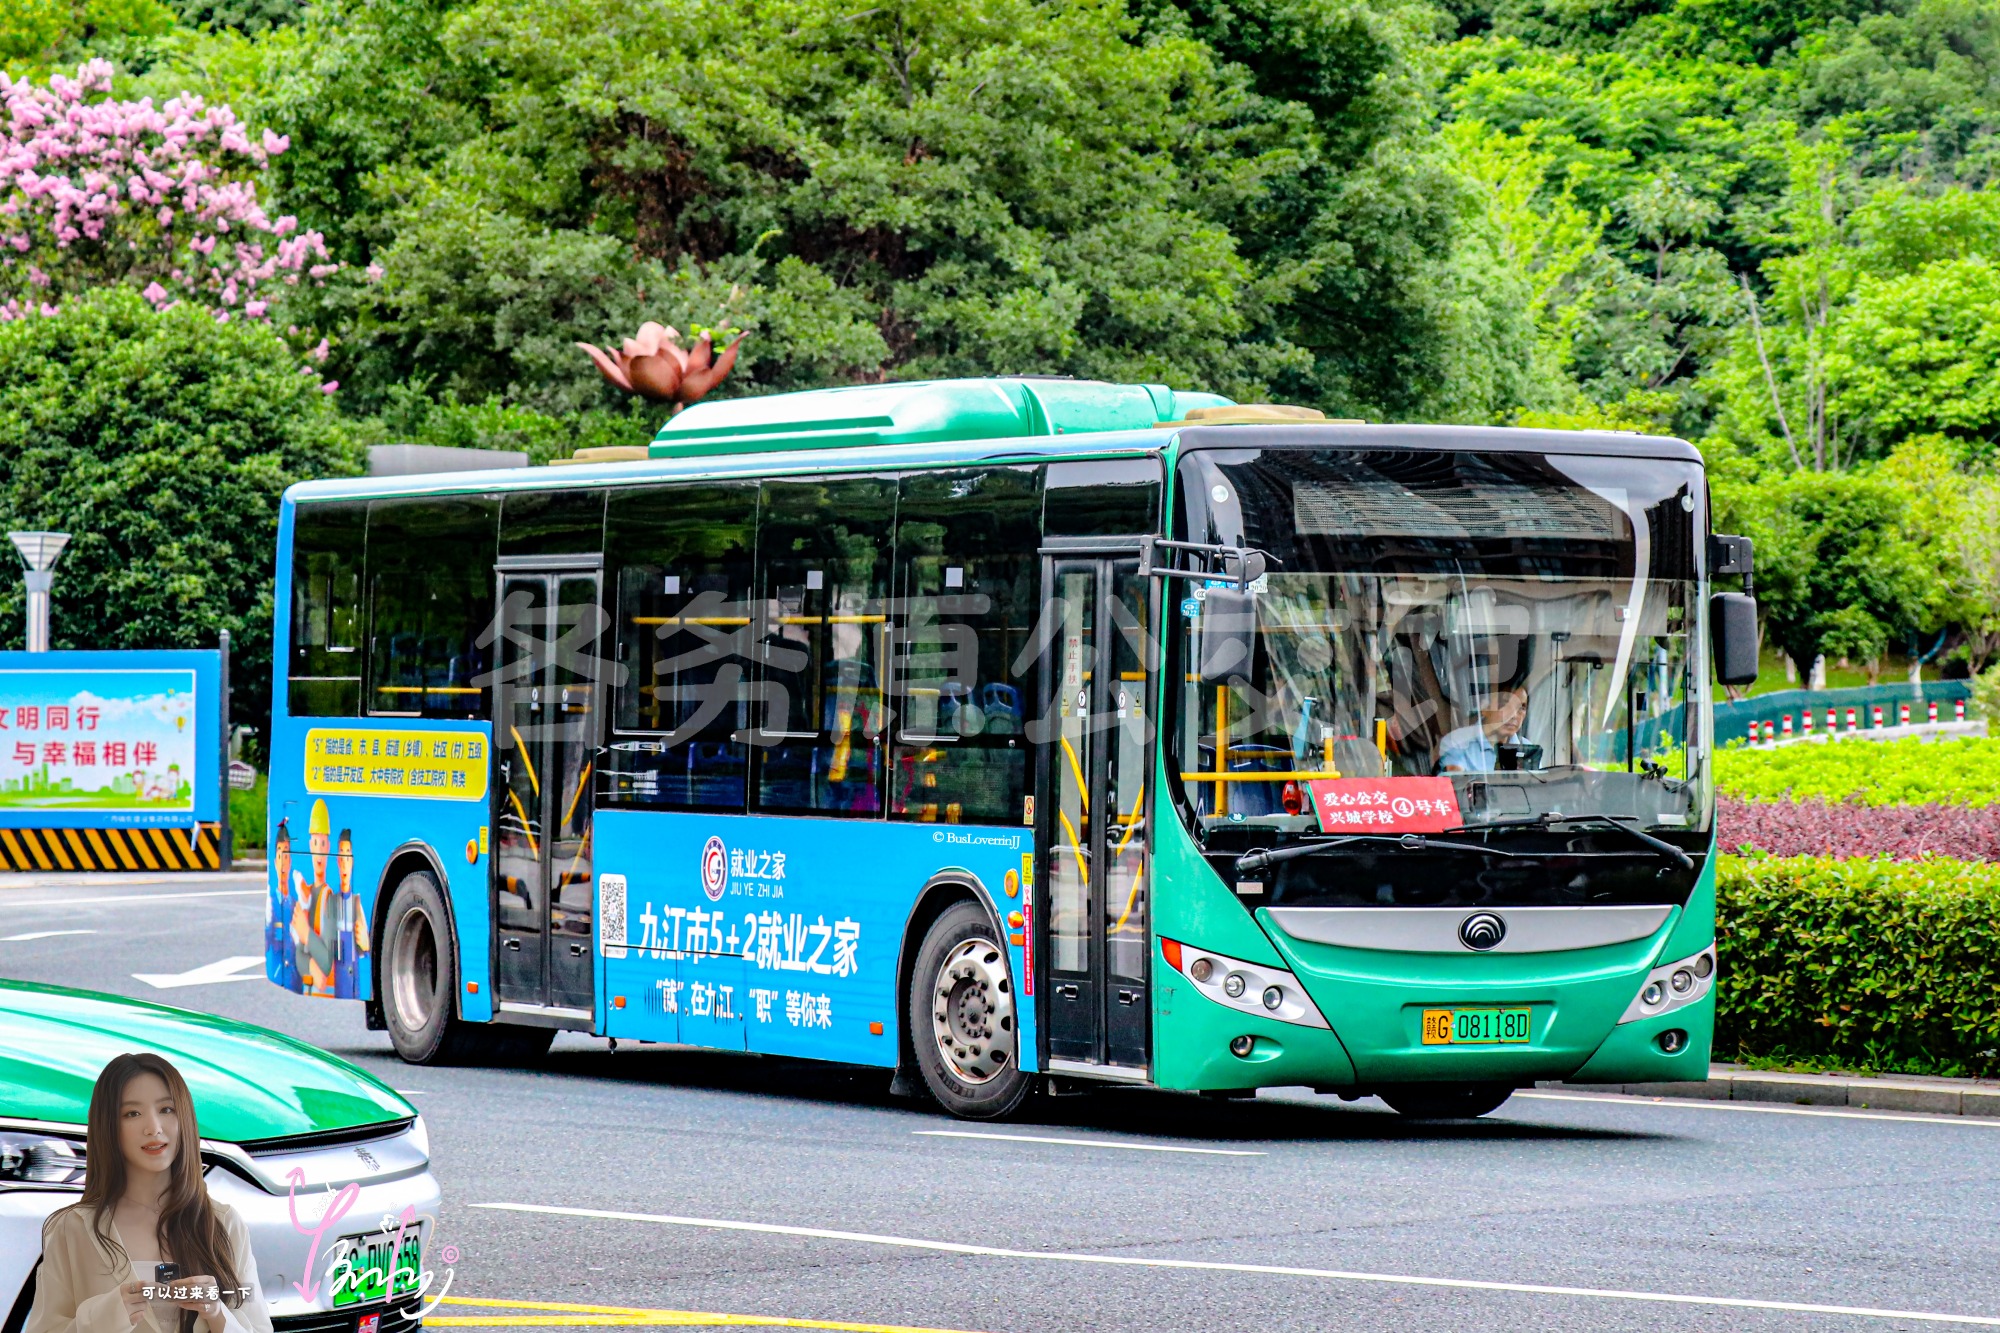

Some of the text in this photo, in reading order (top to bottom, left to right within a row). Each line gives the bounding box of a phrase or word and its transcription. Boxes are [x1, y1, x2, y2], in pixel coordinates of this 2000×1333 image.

[1068, 638, 1078, 684] 禁止手扶
[12, 741, 157, 766] 与幸福相伴
[1323, 790, 1389, 807] 爱心公交
[1329, 809, 1394, 825] 兴城学校
[730, 848, 786, 880] 就业之家
[730, 882, 742, 895] JIU
[744, 883, 754, 896] YE
[757, 883, 770, 897] ZHI
[771, 885, 784, 898] JIA
[637, 901, 860, 978] 九江市5+2就业之家
